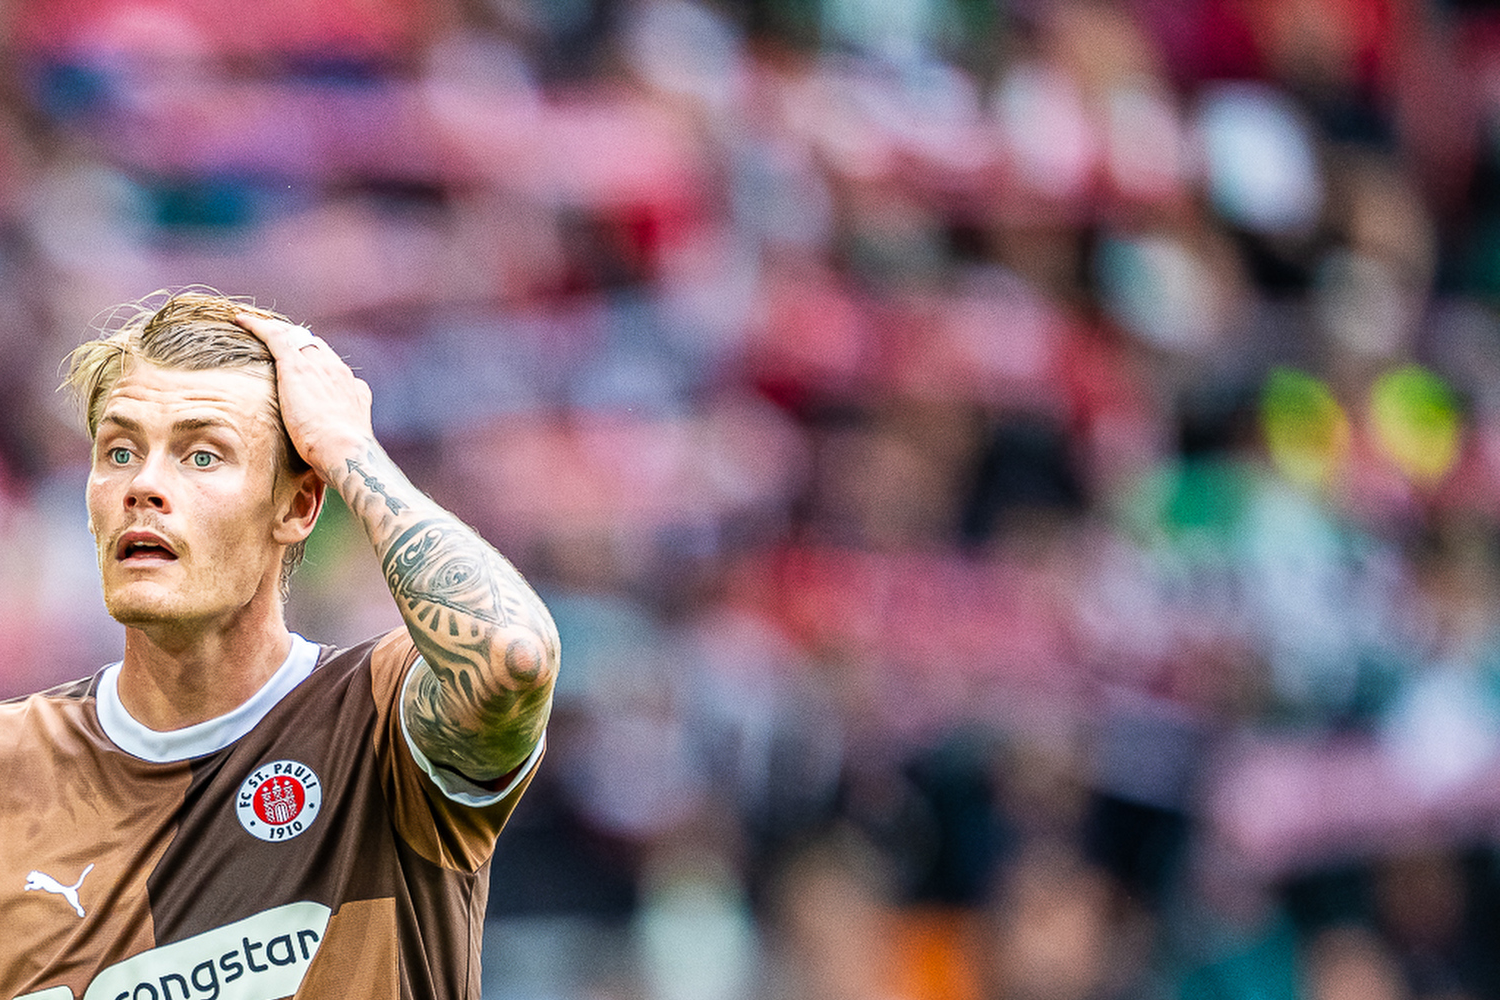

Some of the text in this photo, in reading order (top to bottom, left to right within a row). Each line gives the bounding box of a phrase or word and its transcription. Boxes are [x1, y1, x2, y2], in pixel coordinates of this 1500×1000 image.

[239, 763, 317, 808] FC ST. PAULI
[269, 821, 303, 839] 1910
